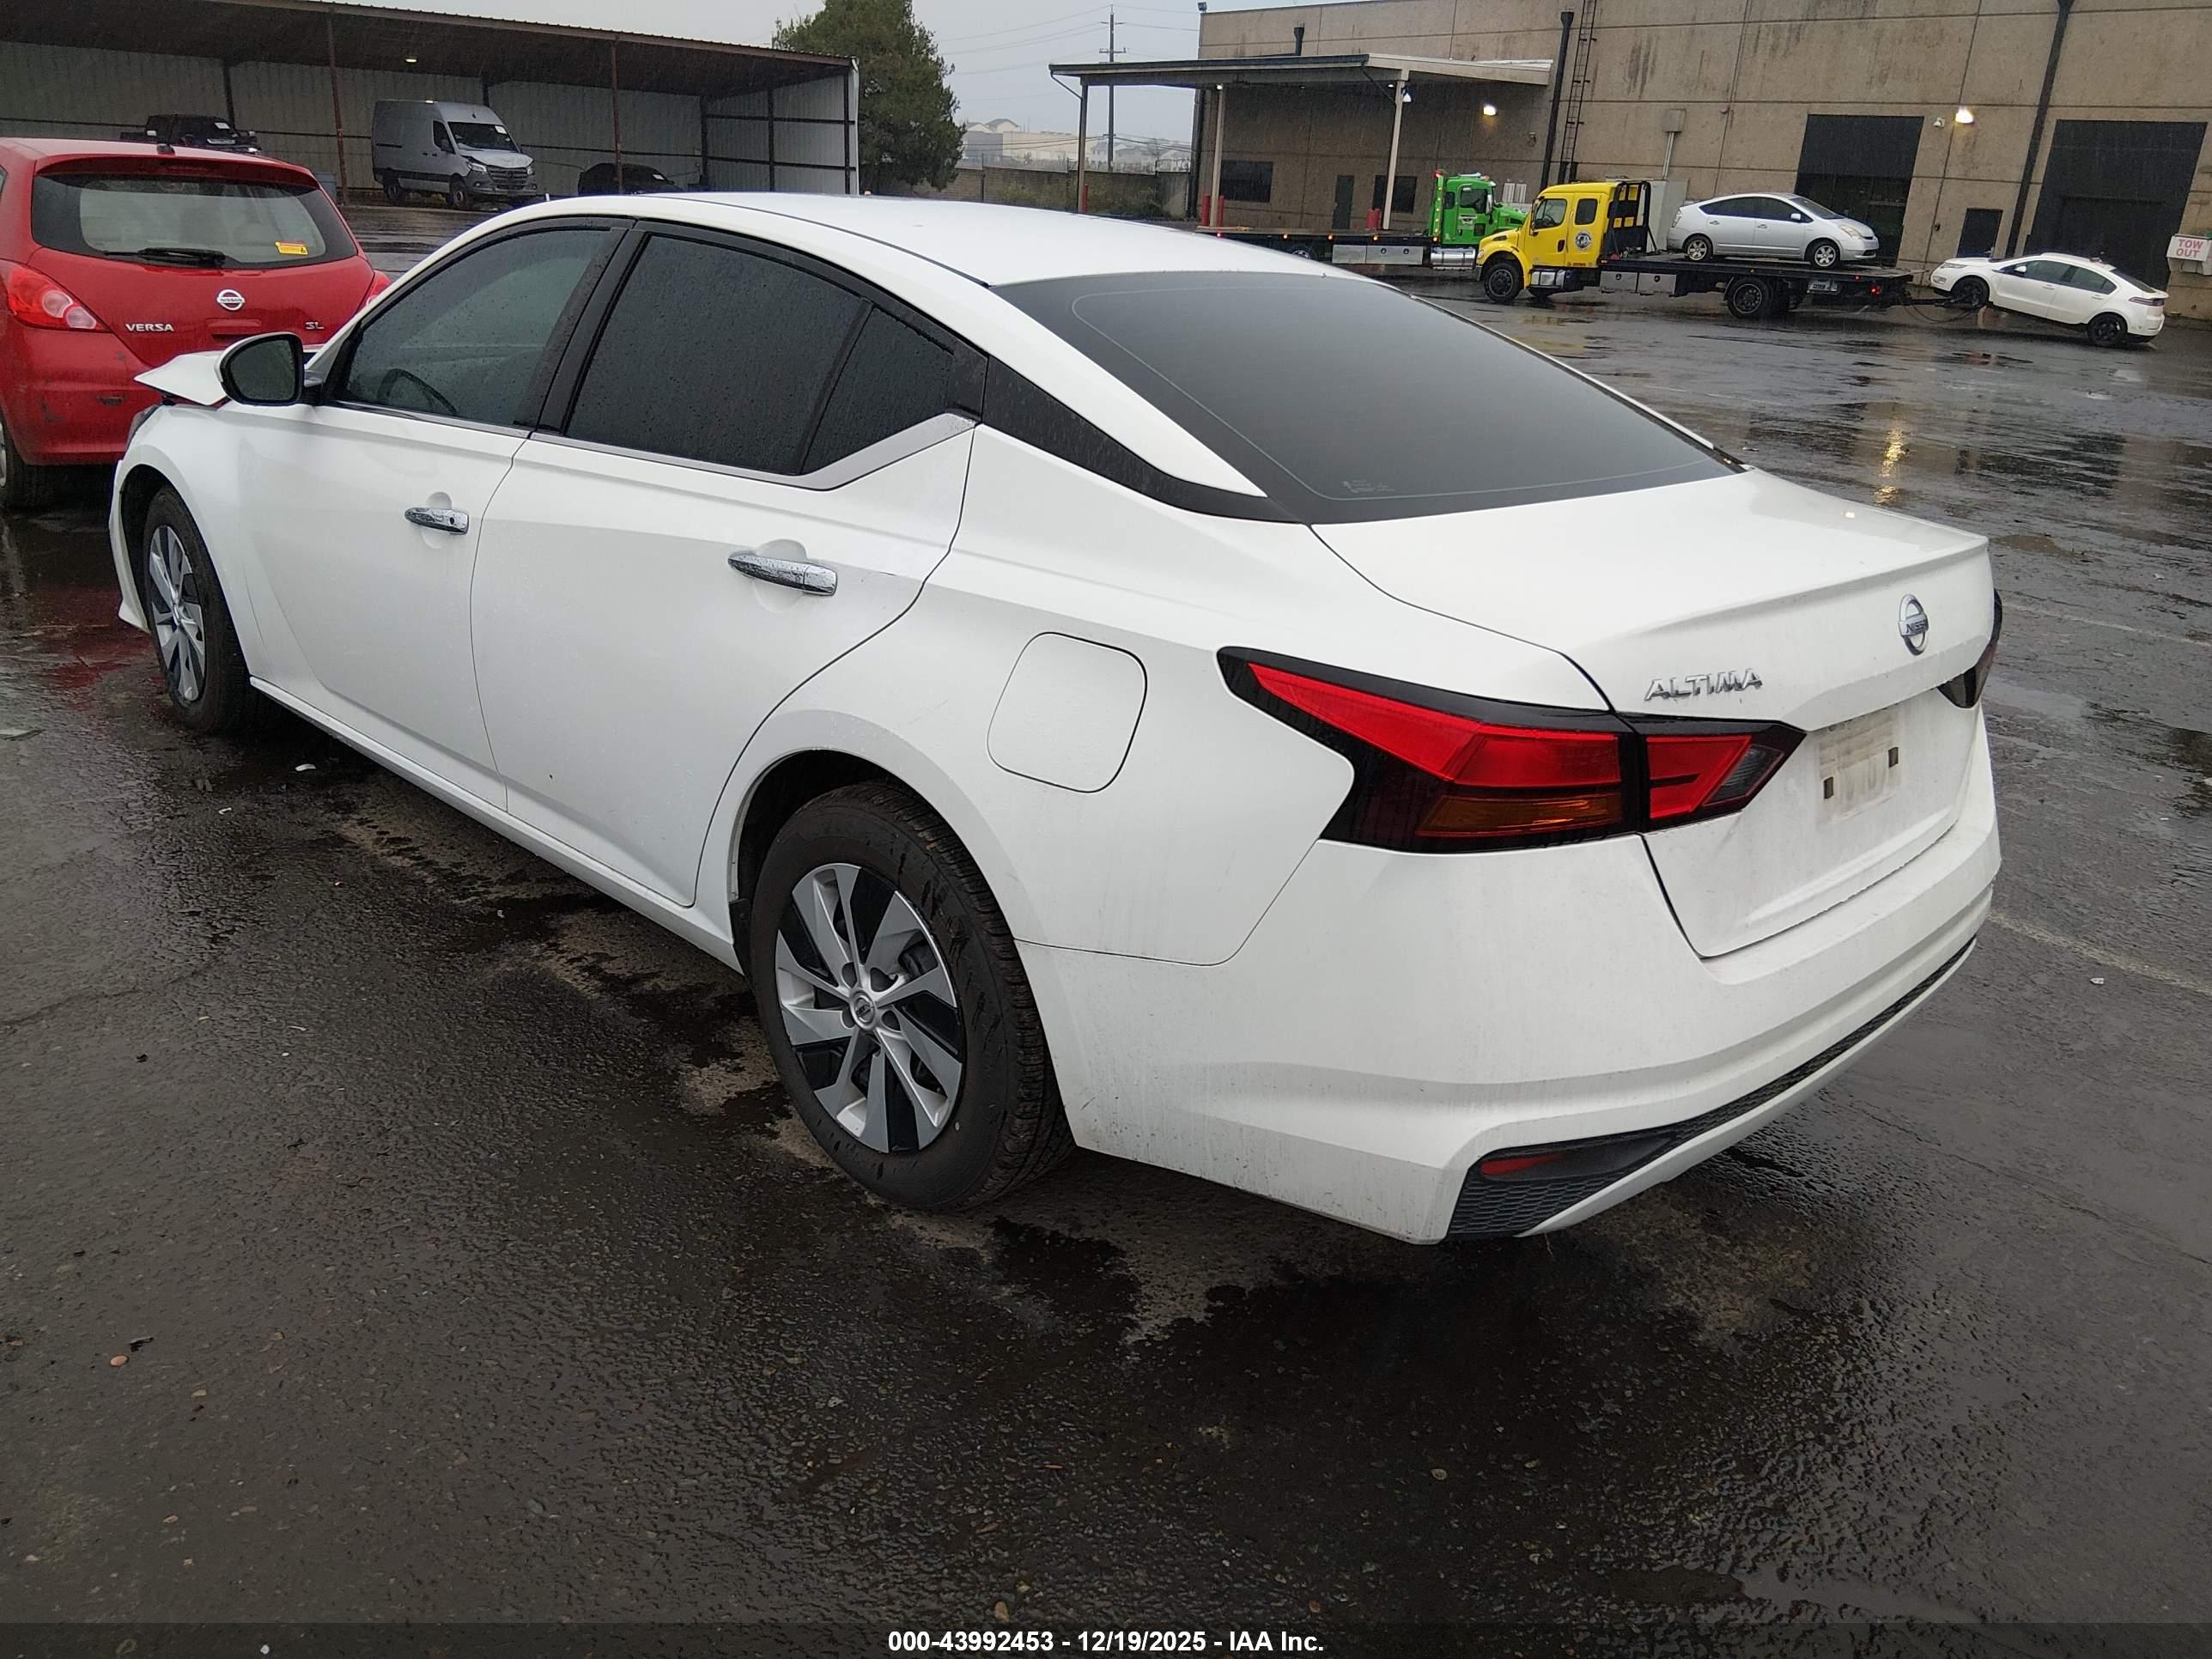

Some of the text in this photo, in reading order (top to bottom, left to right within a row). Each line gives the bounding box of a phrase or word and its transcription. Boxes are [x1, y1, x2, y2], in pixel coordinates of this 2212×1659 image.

[2178, 239, 2204, 249] TOW
[2176, 248, 2200, 258] OUT
[125, 323, 174, 332] VERSA
[305, 321, 325, 330] SL
[1644, 668, 1762, 701] ALTIMA
